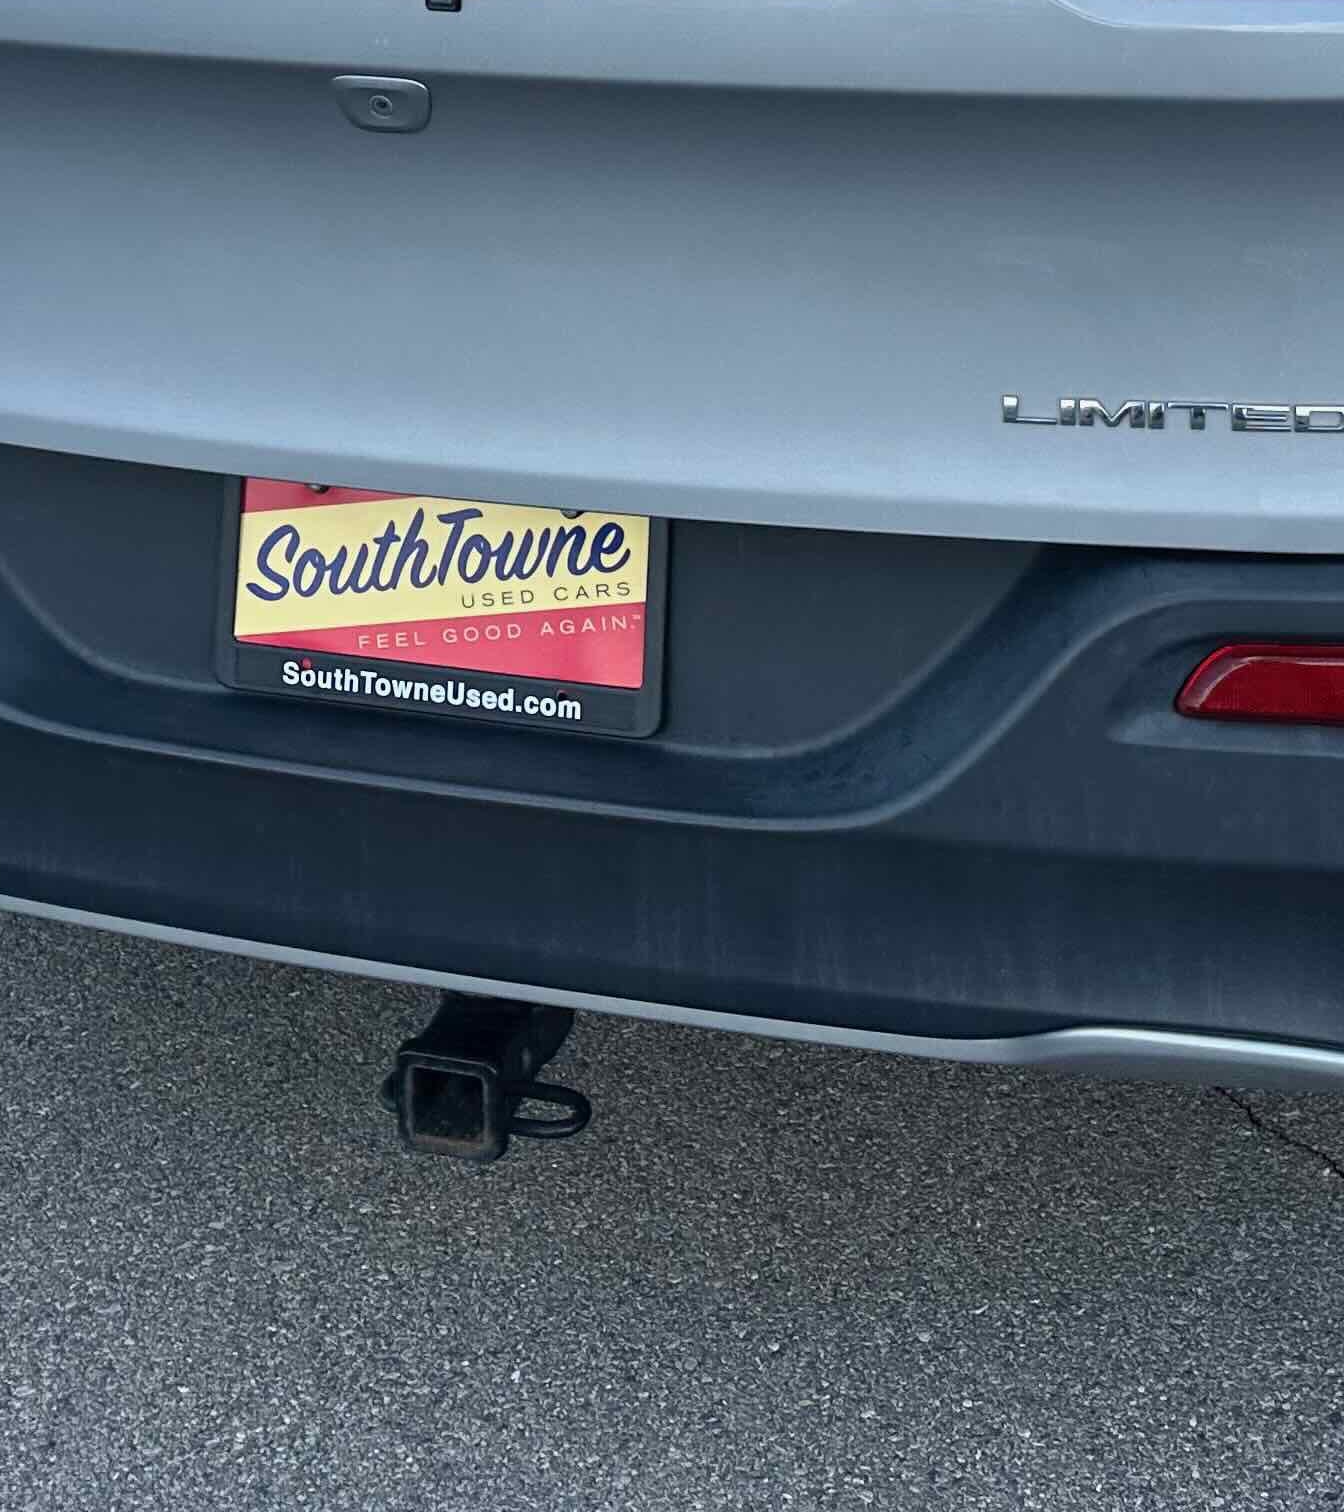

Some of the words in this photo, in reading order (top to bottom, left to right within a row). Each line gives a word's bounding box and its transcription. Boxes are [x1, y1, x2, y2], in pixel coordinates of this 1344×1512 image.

[246, 507, 631, 601] SouthTowne
[461, 589, 535, 609] USED
[553, 581, 631, 601] CARS
[358, 631, 425, 649] FEEL
[442, 623, 522, 644] GOOD
[282, 660, 582, 721] SouthTowneUsed.com
